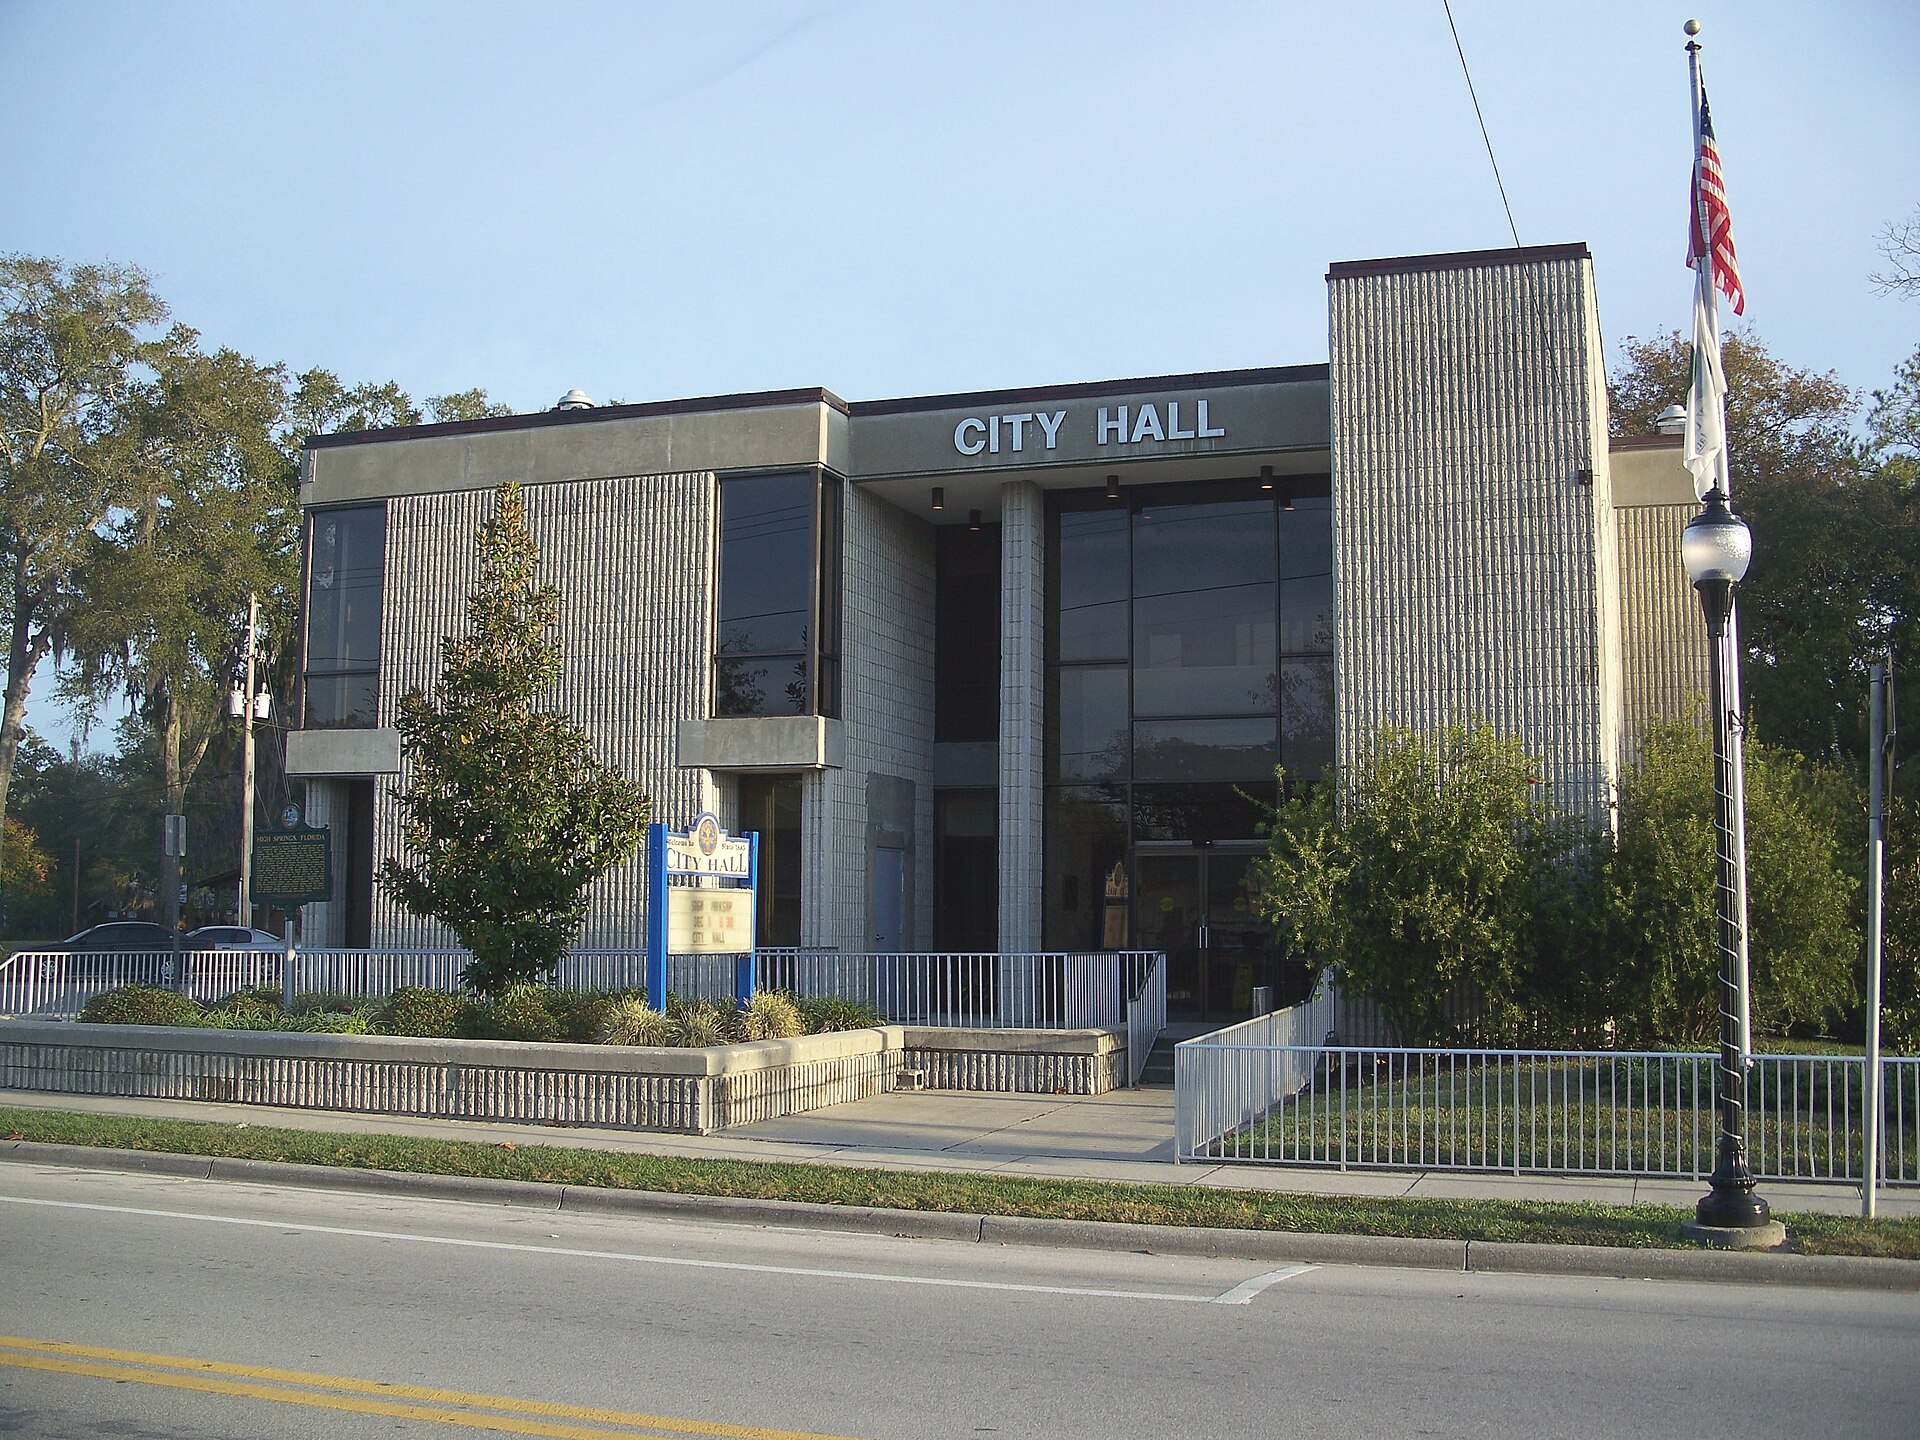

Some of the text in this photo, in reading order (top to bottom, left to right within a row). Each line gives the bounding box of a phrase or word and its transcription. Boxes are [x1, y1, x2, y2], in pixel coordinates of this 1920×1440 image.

[953, 400, 1226, 456] CITY HALL
[256, 835, 271, 843] HIGH
[300, 833, 326, 841] FLORIDA
[667, 847, 747, 873] CITY HALL
